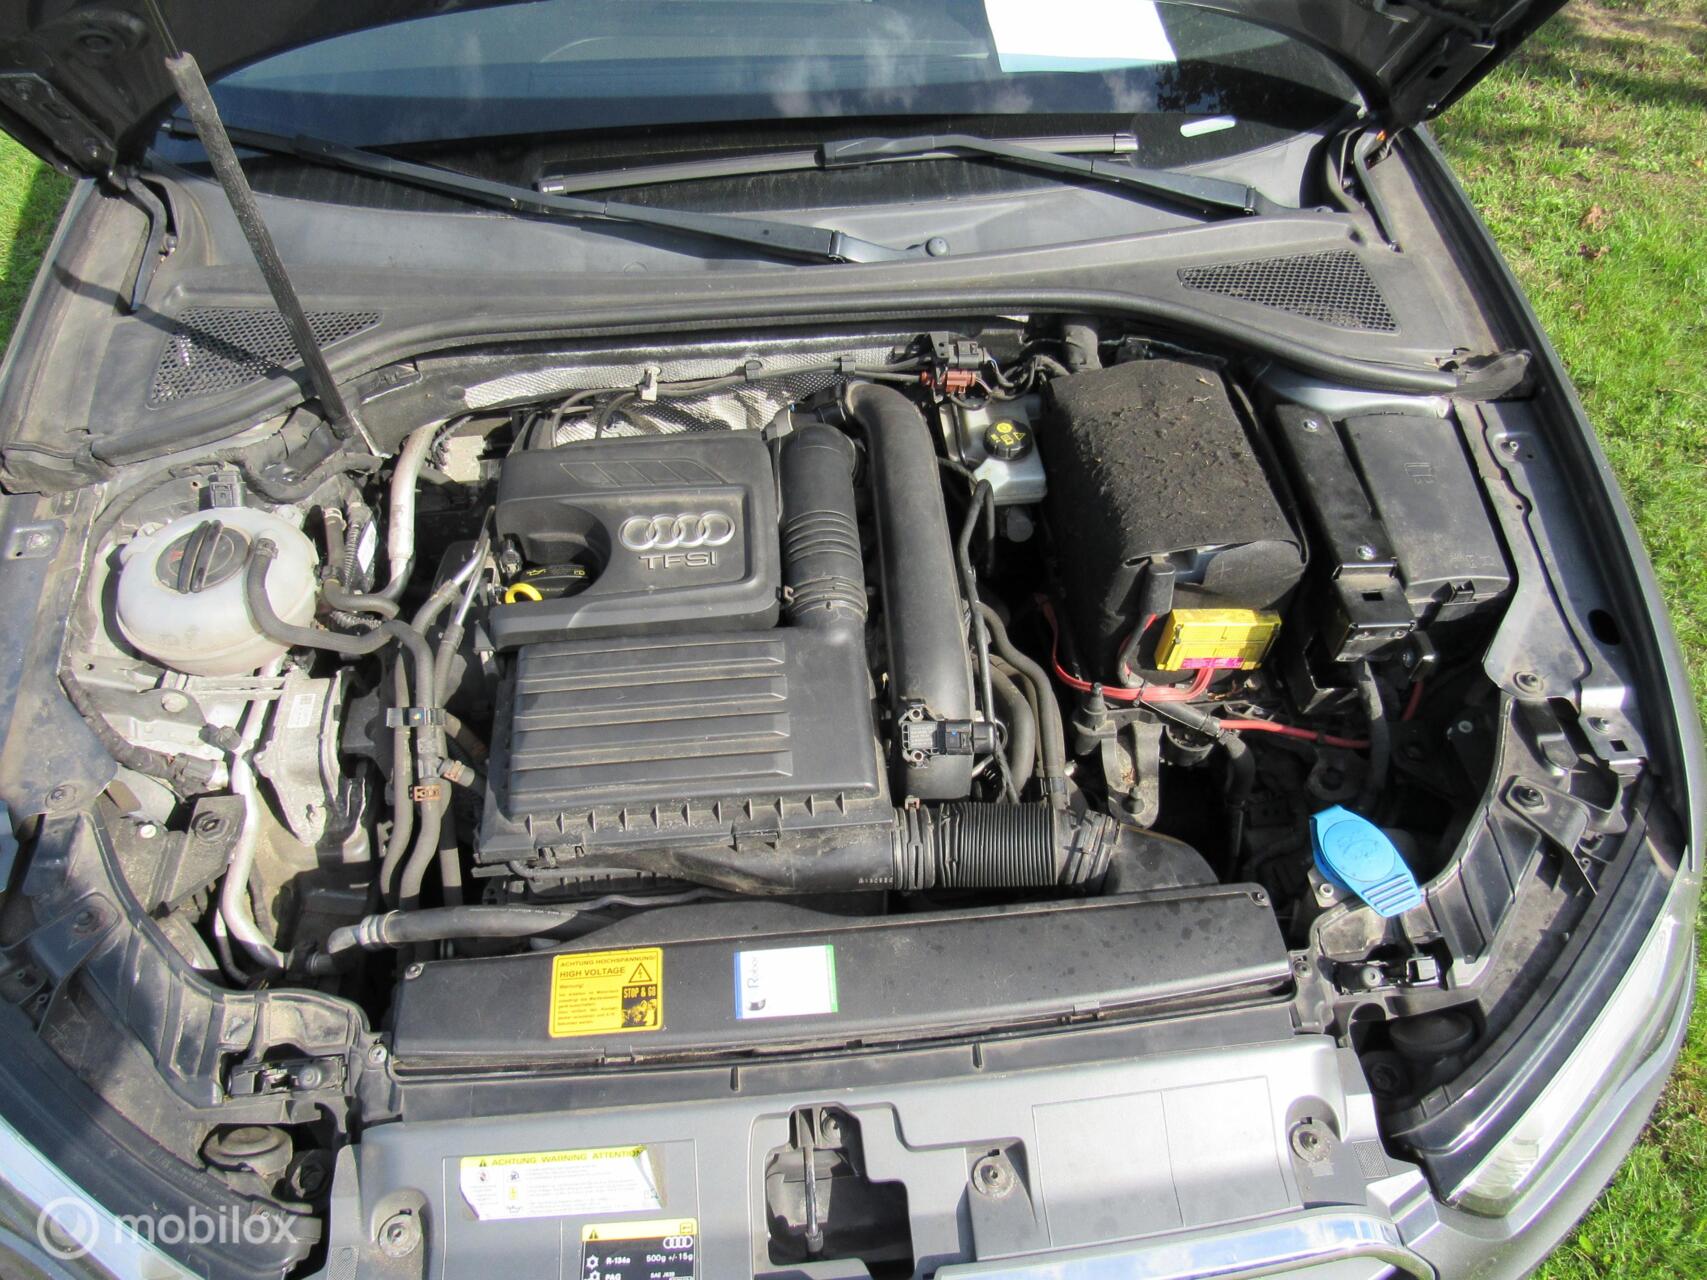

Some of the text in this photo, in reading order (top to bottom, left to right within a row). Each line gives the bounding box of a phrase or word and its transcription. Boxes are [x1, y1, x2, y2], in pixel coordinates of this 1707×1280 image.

[639, 551, 717, 570] TFSI
[559, 966, 625, 979] HIGH VOLTAGE
[624, 987, 640, 999] STOP
[491, 1156, 537, 1167] ACHTUNG
[541, 1152, 588, 1163] WARNING
